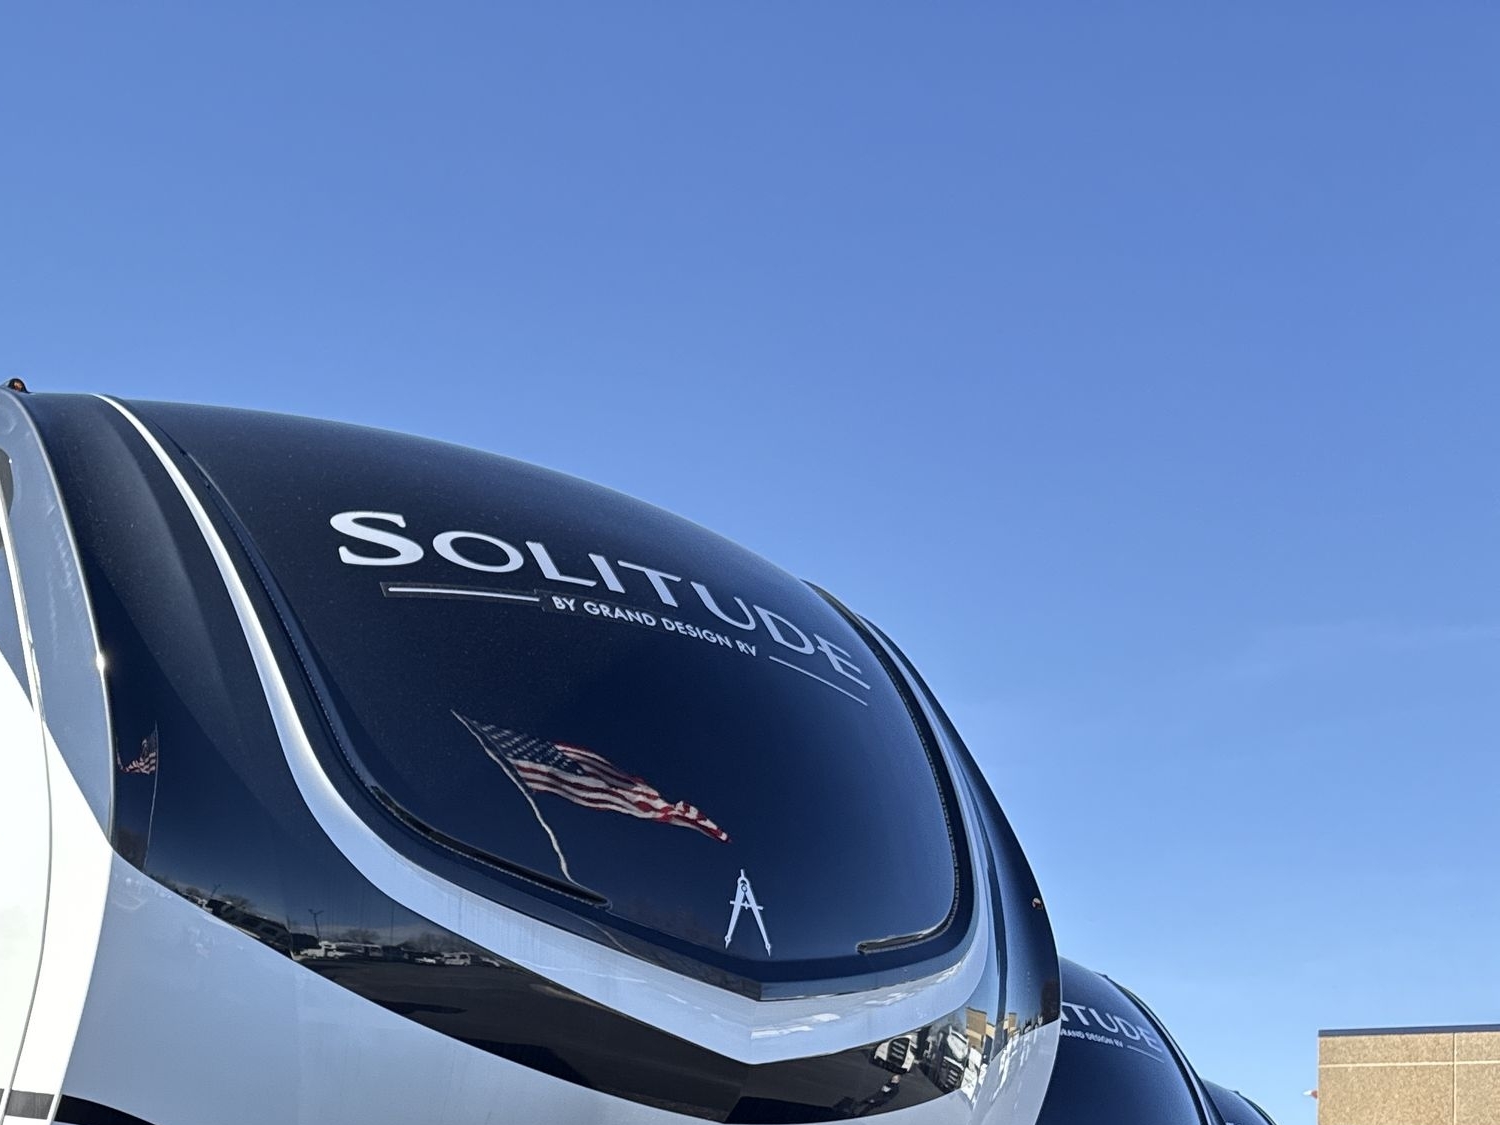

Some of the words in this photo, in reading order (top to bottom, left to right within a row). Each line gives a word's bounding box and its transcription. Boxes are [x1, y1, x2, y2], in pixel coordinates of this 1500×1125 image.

[329, 510, 871, 690] SOLITUDE
[551, 595, 576, 612] BY
[582, 600, 657, 627] GRAND
[660, 616, 733, 649] DESIGN
[735, 639, 758, 657] RV
